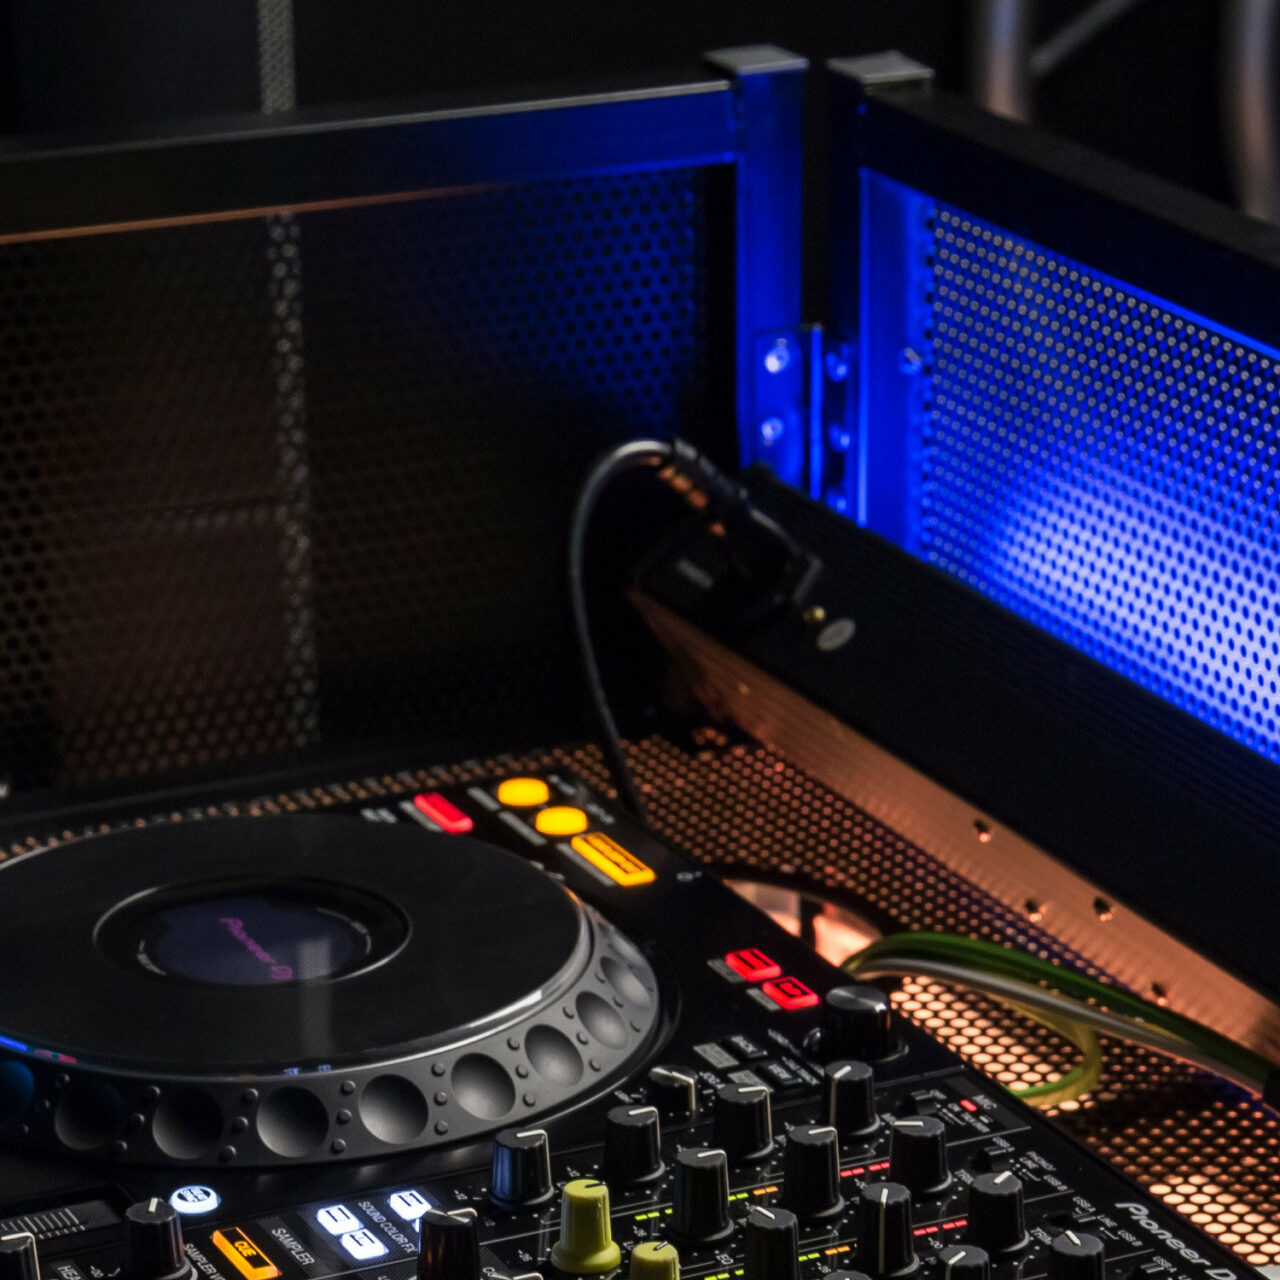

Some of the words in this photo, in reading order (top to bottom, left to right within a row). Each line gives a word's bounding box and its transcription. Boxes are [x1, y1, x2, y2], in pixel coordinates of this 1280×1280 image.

[234, 1240, 256, 1259] CUE
[271, 1227, 315, 1266] SAMPLER
[1115, 1202, 1211, 1267] Pioneer
